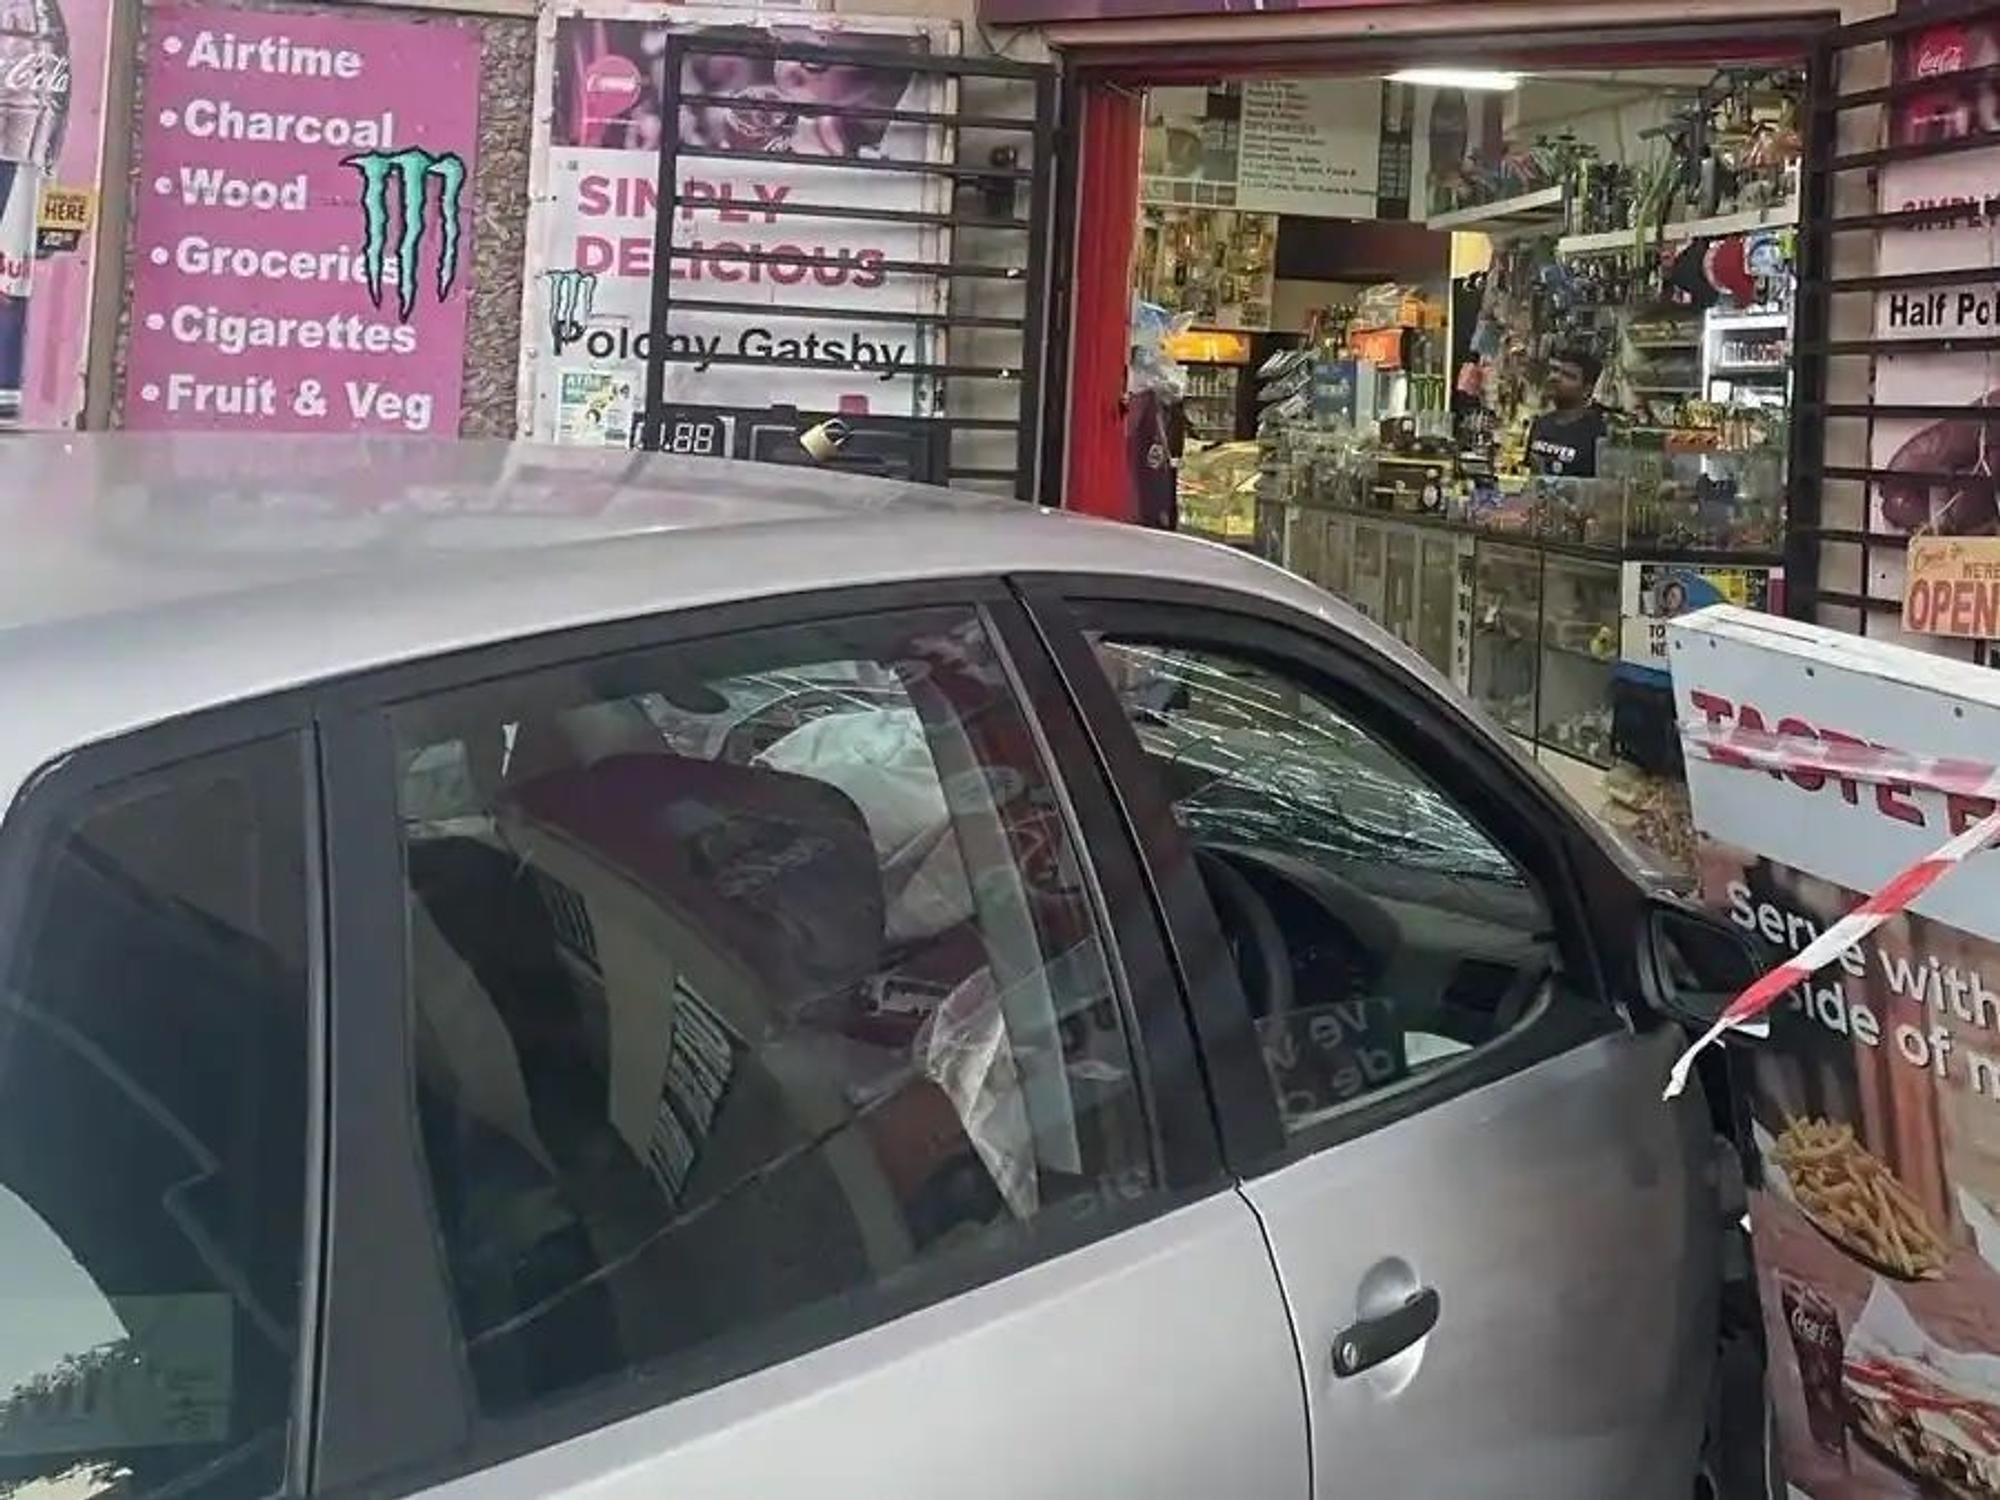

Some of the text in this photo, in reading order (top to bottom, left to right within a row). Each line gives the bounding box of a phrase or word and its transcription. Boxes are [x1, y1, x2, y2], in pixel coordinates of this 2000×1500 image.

[187, 31, 362, 77] Airtime
[184, 100, 393, 148] Charcoal
[45, 202, 84, 222] HERE
[180, 167, 307, 210] Wood
[171, 305, 416, 354] Cigarettes
[1890, 293, 1946, 326] Half
[738, 328, 907, 381] Gatsby
[166, 374, 434, 430] Fruit & Veg
[1909, 578, 2000, 636] OPEN
[1877, 948, 2000, 1030] with
[1896, 1025, 1954, 1079] of
